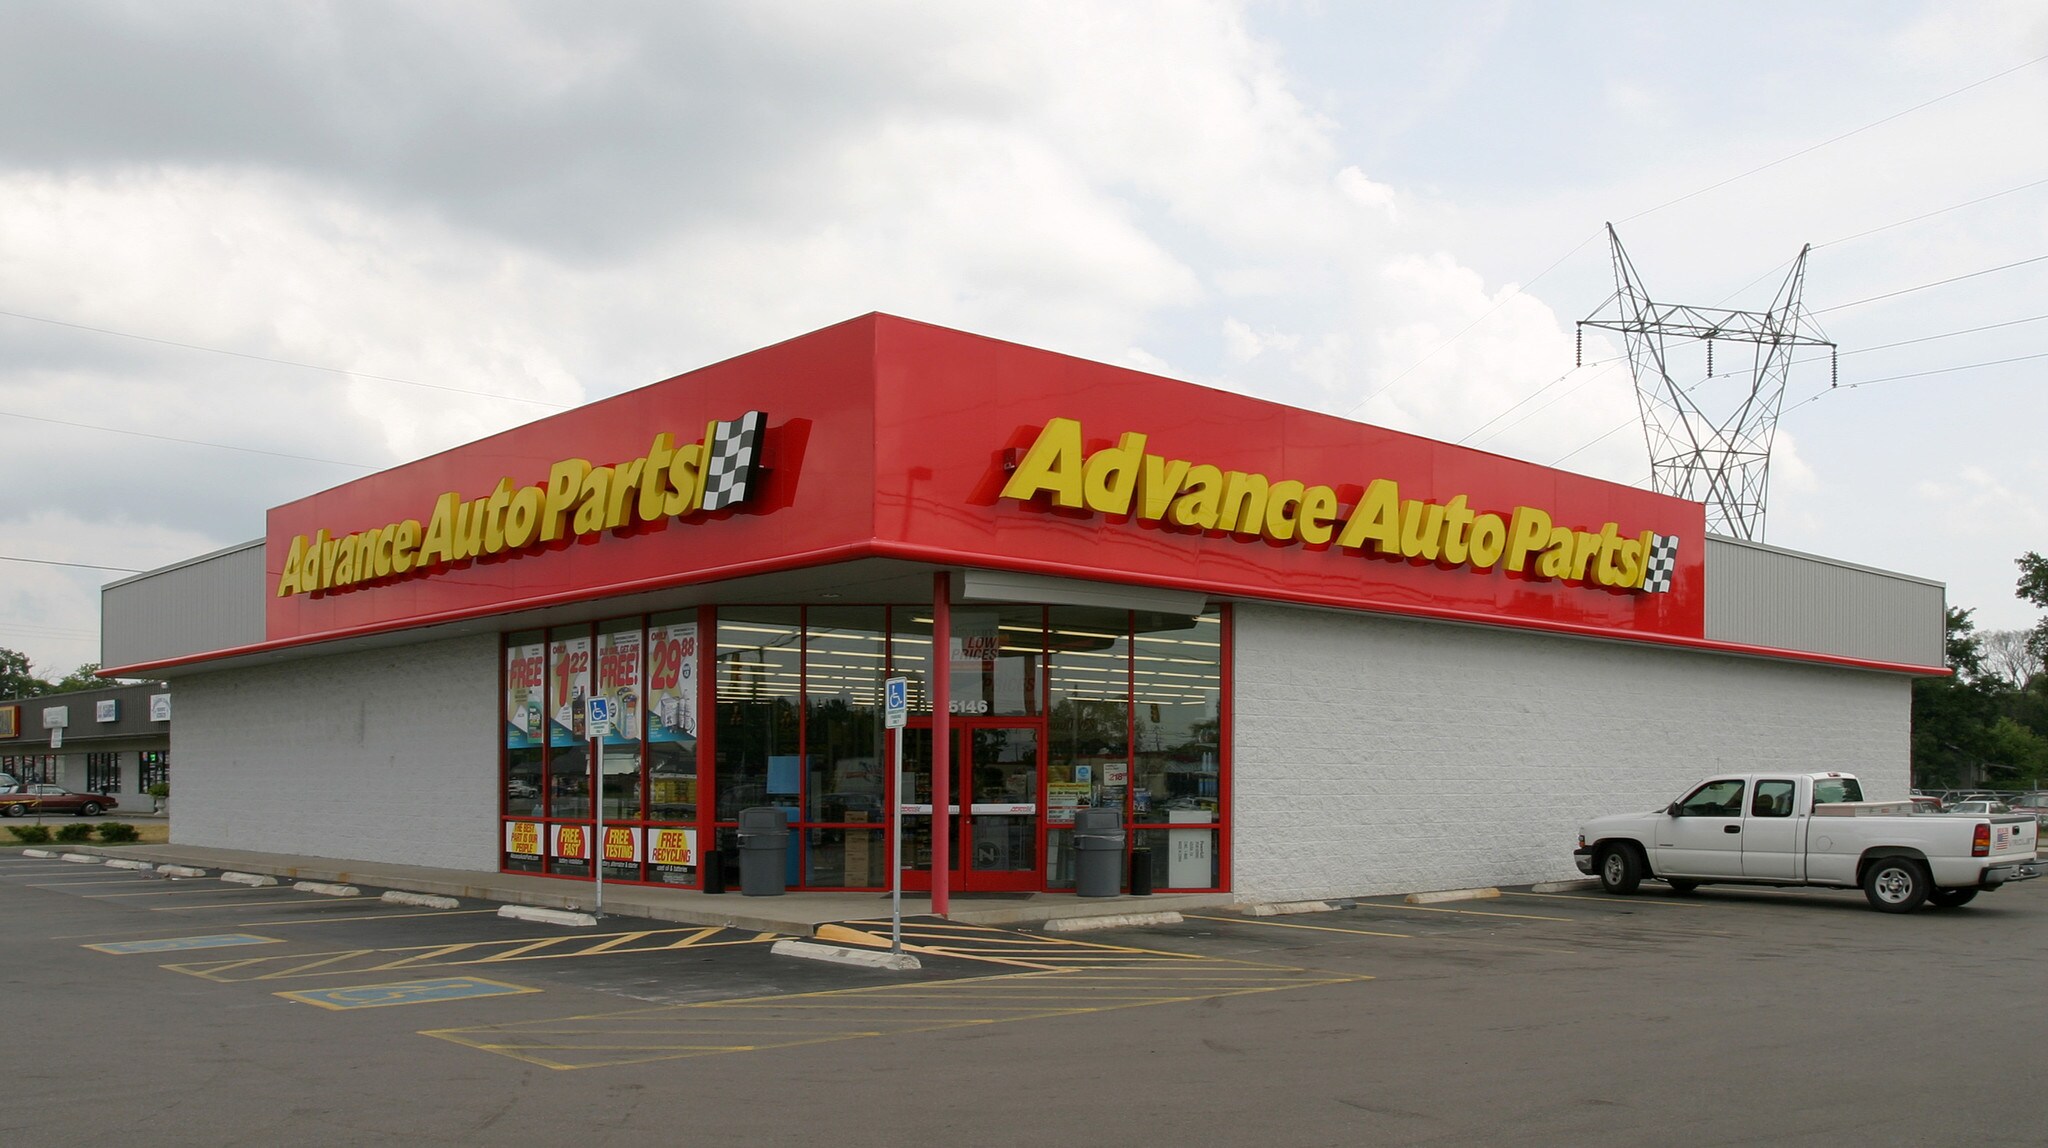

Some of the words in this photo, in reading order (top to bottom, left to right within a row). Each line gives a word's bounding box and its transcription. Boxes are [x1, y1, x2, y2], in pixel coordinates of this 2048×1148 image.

[999, 417, 1338, 545] Advance
[1336, 479, 1508, 569] Auto
[1507, 506, 1643, 589] Parts
[277, 518, 421, 598] Advance
[416, 476, 547, 568] Auto
[539, 432, 703, 543] Parts
[620, 644, 629, 654] GET
[630, 643, 639, 652] ONE
[967, 636, 997, 648] LOW
[570, 650, 588, 674] 22
[600, 652, 640, 688] FREE!
[652, 639, 681, 690] 29
[681, 636, 695, 657] 88
[510, 656, 543, 688] FREE
[949, 700, 988, 713] 5146
[609, 829, 630, 845] FREE
[660, 832, 682, 848] FREE
[563, 843, 580, 856] FAST
[605, 844, 633, 859] TESTING
[652, 848, 691, 863] RECYCLING
